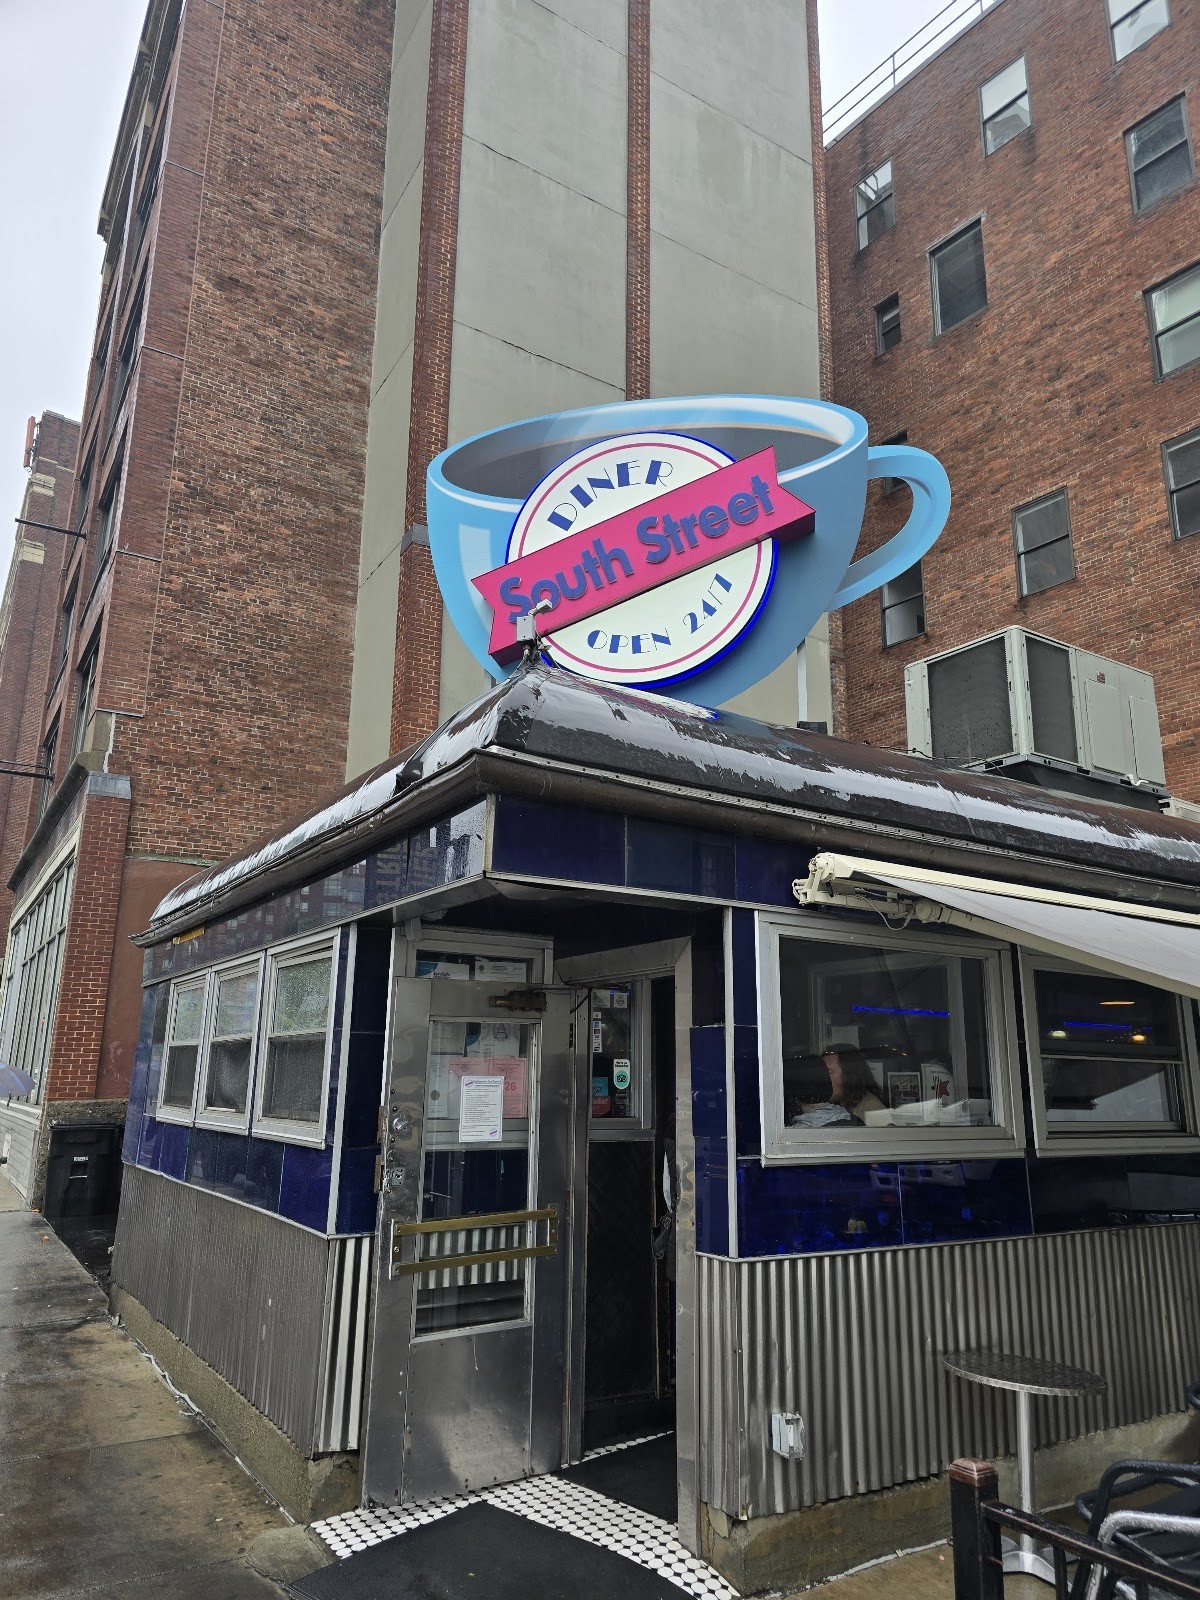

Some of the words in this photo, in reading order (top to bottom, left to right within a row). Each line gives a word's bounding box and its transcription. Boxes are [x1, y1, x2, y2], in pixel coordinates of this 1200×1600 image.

[547, 459, 673, 532] DINER
[499, 537, 634, 624] South
[636, 474, 775, 564] Street
[587, 628, 672, 654] OPEN
[682, 573, 733, 634] 24/7
